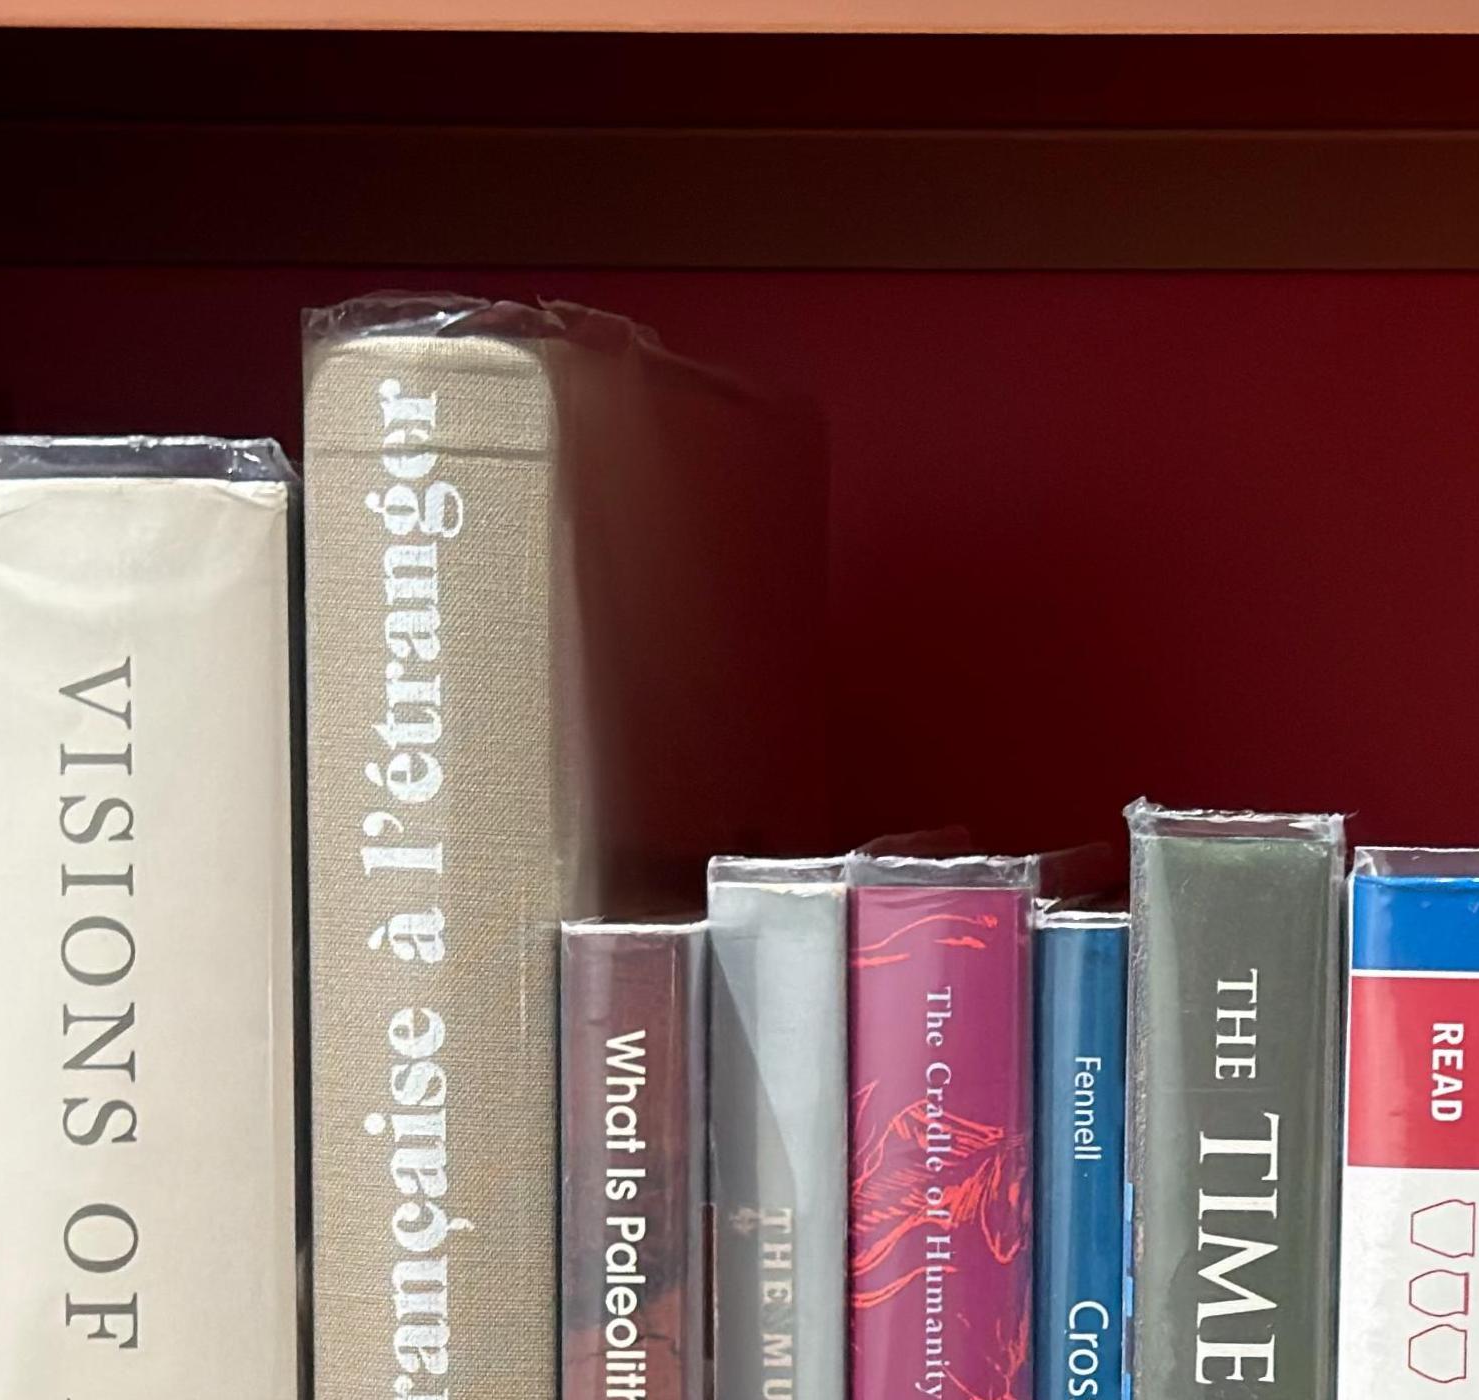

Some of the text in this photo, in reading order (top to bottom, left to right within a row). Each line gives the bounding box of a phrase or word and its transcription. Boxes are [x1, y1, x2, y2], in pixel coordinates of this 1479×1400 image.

[364, 378, 462, 876] l'étranger
[58, 655, 137, 1146] VISIONS
[370, 909, 444, 963] à
[924, 986, 955, 1049] The
[1215, 969, 1258, 1081] THE
[605, 1030, 646, 1154] What
[924, 1064, 952, 1171] Cradle
[1074, 1056, 1101, 1161] Fennell
[1431, 1022, 1463, 1123] READ
[607, 1171, 644, 1200] Is
[924, 1182, 952, 1222] of
[63, 1203, 139, 1350] OF
[760, 1206, 793, 1303] THE
[1194, 1112, 1278, 1386] TIME
[915, 1235, 952, 1400] Humanity
